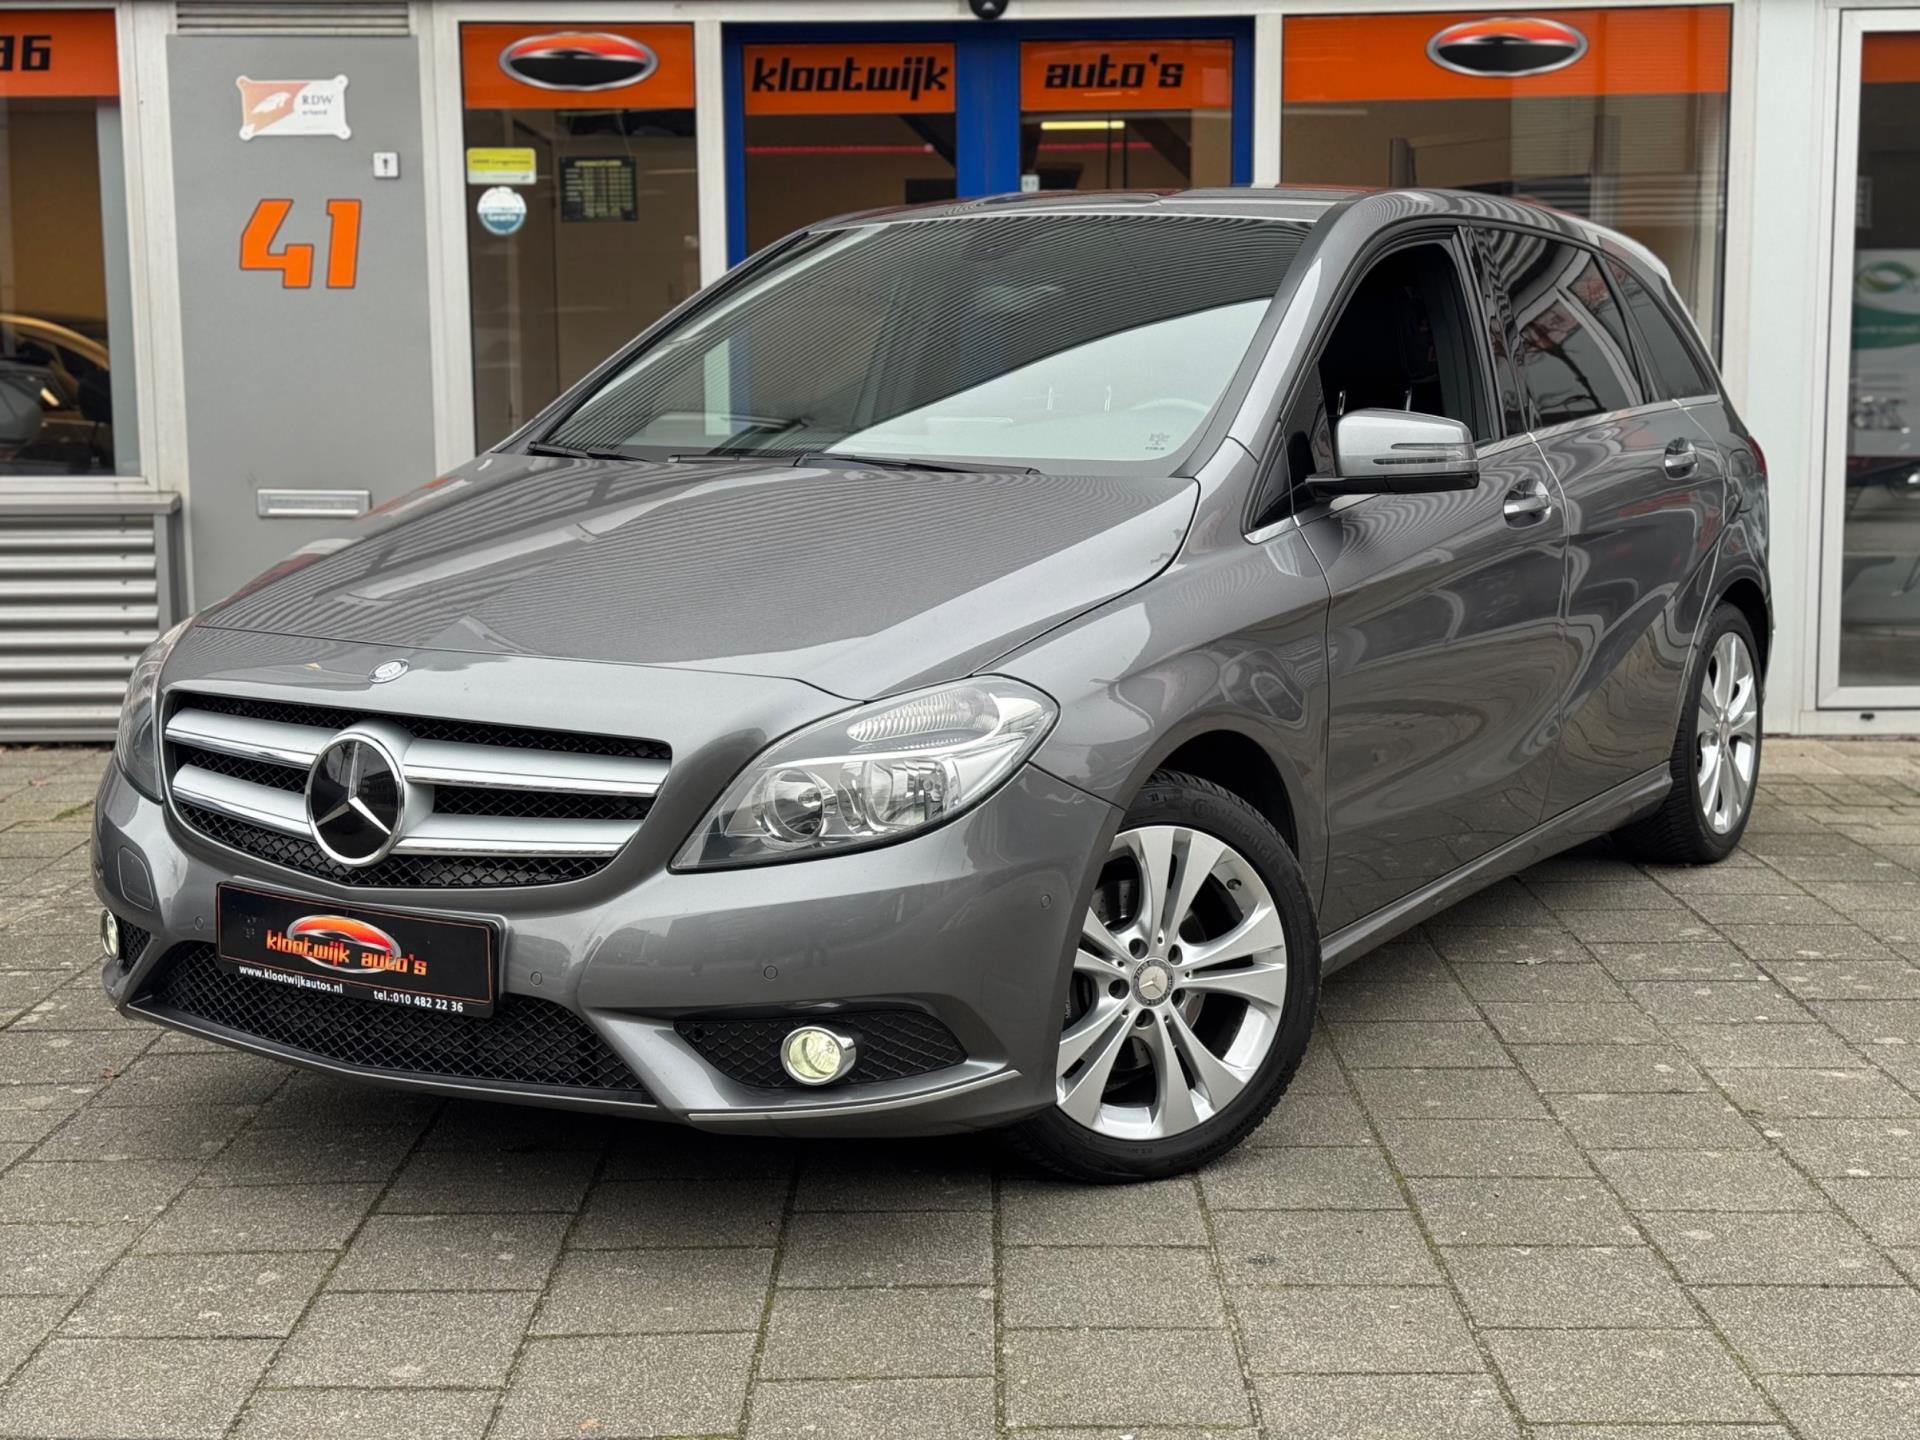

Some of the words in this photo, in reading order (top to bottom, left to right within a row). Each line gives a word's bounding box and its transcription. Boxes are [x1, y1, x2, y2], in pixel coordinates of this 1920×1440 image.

[752, 56, 949, 101] klootwijk
[1044, 53, 1185, 89] auto's
[239, 198, 362, 289] 41
[265, 930, 350, 968] klootwijk
[360, 949, 428, 976] auto's
[238, 965, 343, 994] www.klootwijkautos.nl
[413, 995, 433, 1008] 482
[435, 999, 448, 1011] 22
[451, 1001, 464, 1013] 36
